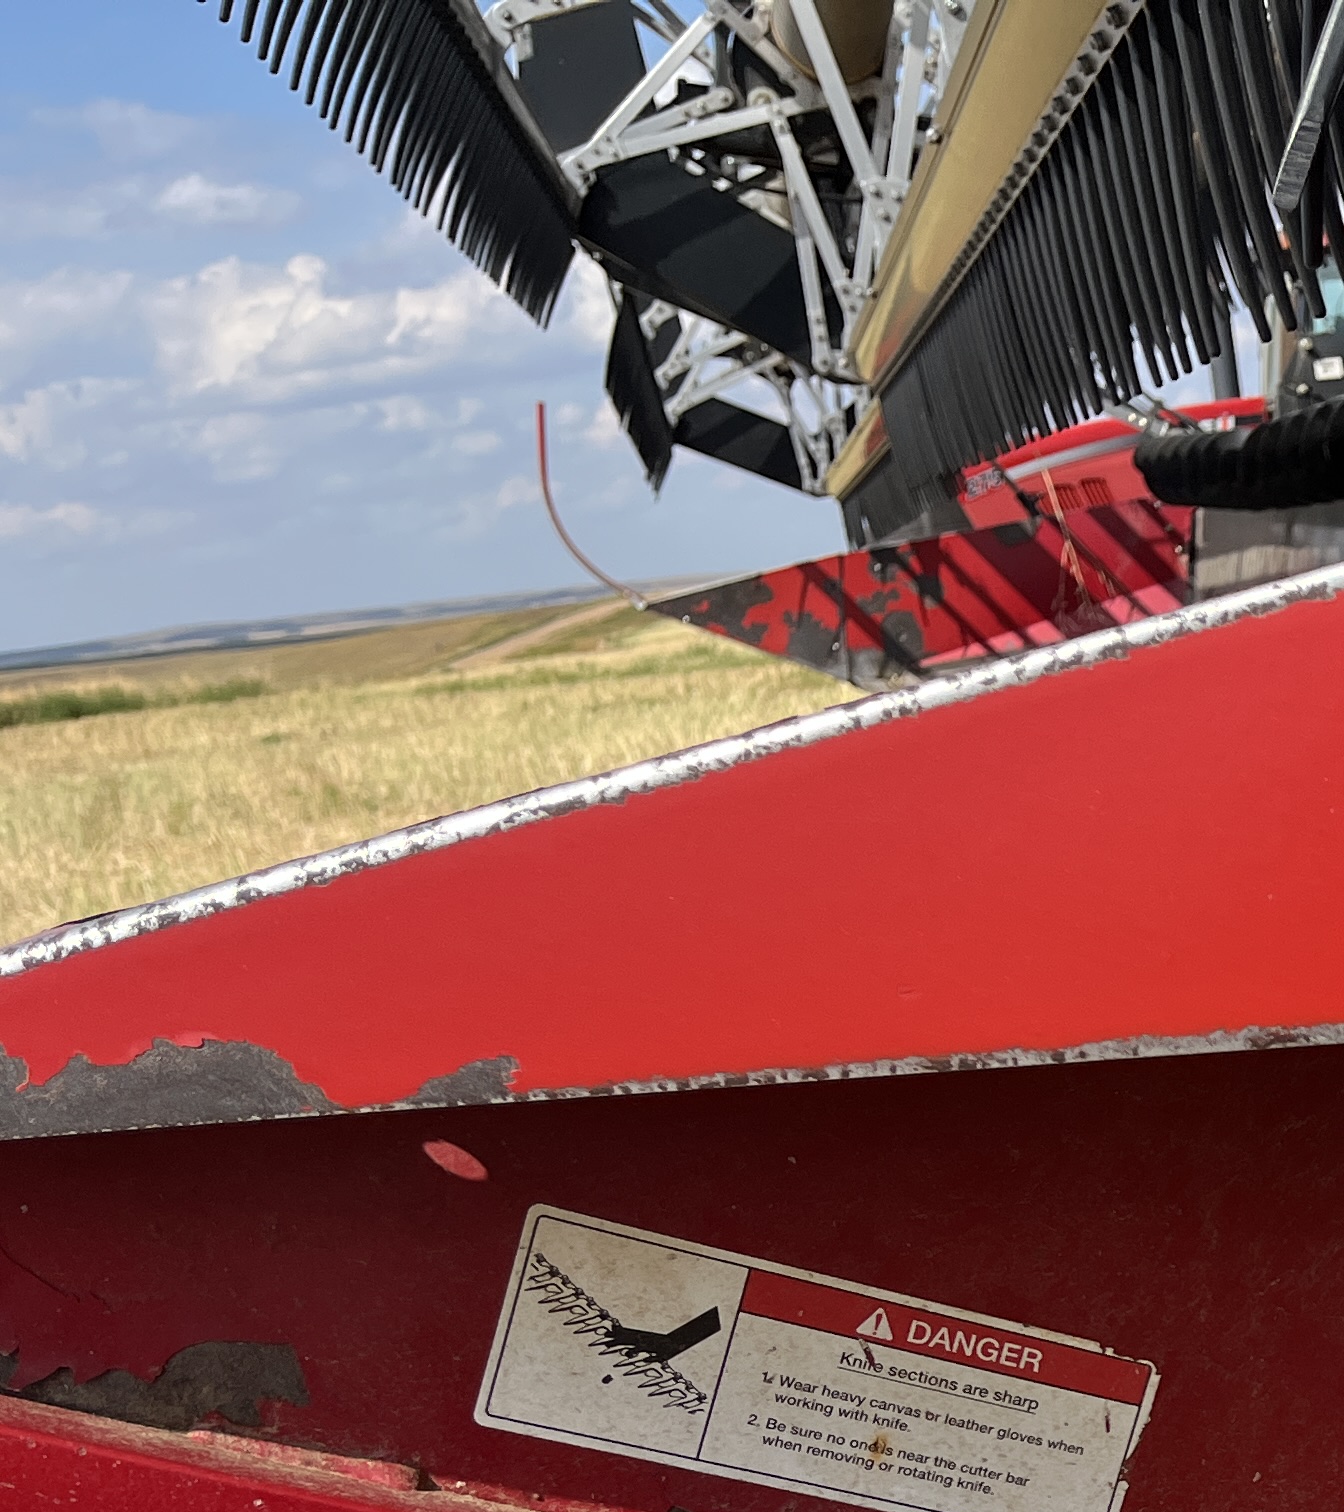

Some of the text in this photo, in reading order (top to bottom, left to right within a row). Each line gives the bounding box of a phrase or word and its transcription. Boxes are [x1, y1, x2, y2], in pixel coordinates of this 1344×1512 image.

[907, 1319, 1043, 1373] DANGER
[774, 1393, 911, 1433] working with knife.
[779, 1374, 819, 1394] Wear
[821, 1384, 867, 1407] heavy
[869, 1399, 921, 1419] canvas
[925, 1410, 941, 1422] or
[944, 1413, 995, 1435] leather
[997, 1427, 1043, 1446] gloves
[1047, 1439, 1084, 1456] when
[888, 1365, 959, 1391] sections
[962, 1383, 989, 1398] are
[992, 1390, 1039, 1412] sharp
[747, 1414, 1031, 1487] 2. Be sure no one is near the cutter bar
[762, 1435, 995, 1495] when removing or rotating knife.
